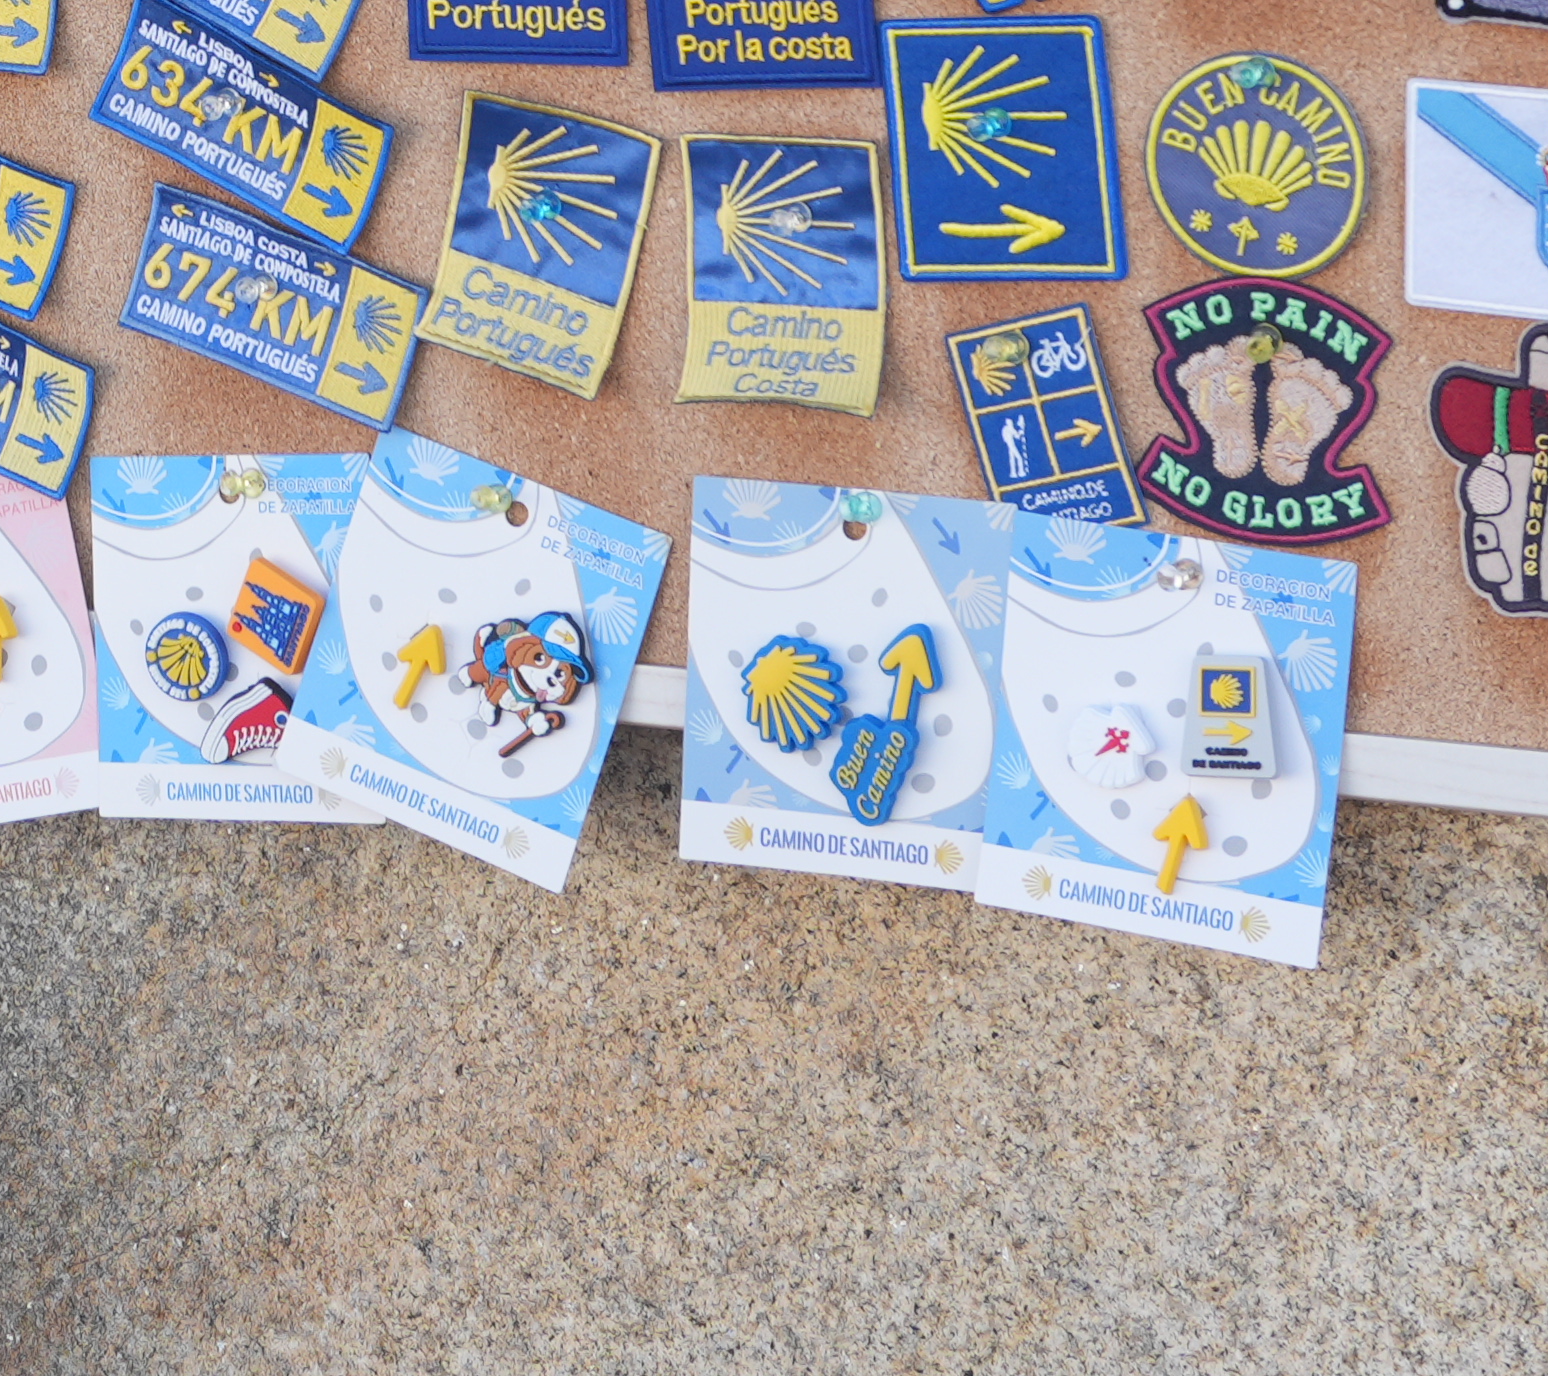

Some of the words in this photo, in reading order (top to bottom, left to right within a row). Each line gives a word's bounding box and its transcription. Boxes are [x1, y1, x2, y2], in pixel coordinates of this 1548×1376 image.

[198, 32, 255, 78] LISBOA
[678, 33, 733, 65] Por
[735, 28, 763, 61] la
[770, 32, 854, 62] costa
[1162, 72, 1244, 151] BUEN
[1259, 70, 1352, 190] CAMINO
[200, 213, 255, 247] LISBOA
[257, 235, 308, 270] COSTA
[462, 266, 589, 337] Camino
[726, 306, 844, 342] Camino
[1165, 293, 1234, 340] NO
[1249, 291, 1368, 364] PAIN
[431, 296, 595, 380] Portugués
[704, 342, 856, 376] Portugués
[733, 372, 820, 398] Costa
[1152, 451, 1212, 508] NO
[1222, 482, 1365, 528] GLORY
[541, 535, 560, 554] DE
[563, 542, 644, 589] ZAPATILLA
[547, 515, 646, 566] DECORACION
[1214, 593, 1237, 609] DE
[1241, 595, 1336, 626] ZAPATILLA
[1216, 569, 1332, 600] DECORACION
[837, 729, 876, 790] Buen
[857, 731, 907, 820] Camino
[167, 782, 222, 802] CAMINO
[224, 783, 242, 802] DE
[244, 784, 314, 804] SANTIAGO
[350, 763, 409, 804] CAMINO
[409, 789, 427, 814] DE
[426, 795, 500, 845] SANTIAGO
[760, 827, 825, 854] CAMINO
[828, 835, 849, 856] DE
[850, 837, 929, 866] SANTIAGO
[1058, 878, 1126, 911] CAMINO
[1127, 893, 1150, 915] DE
[1150, 896, 1234, 932] SANTIAGO
